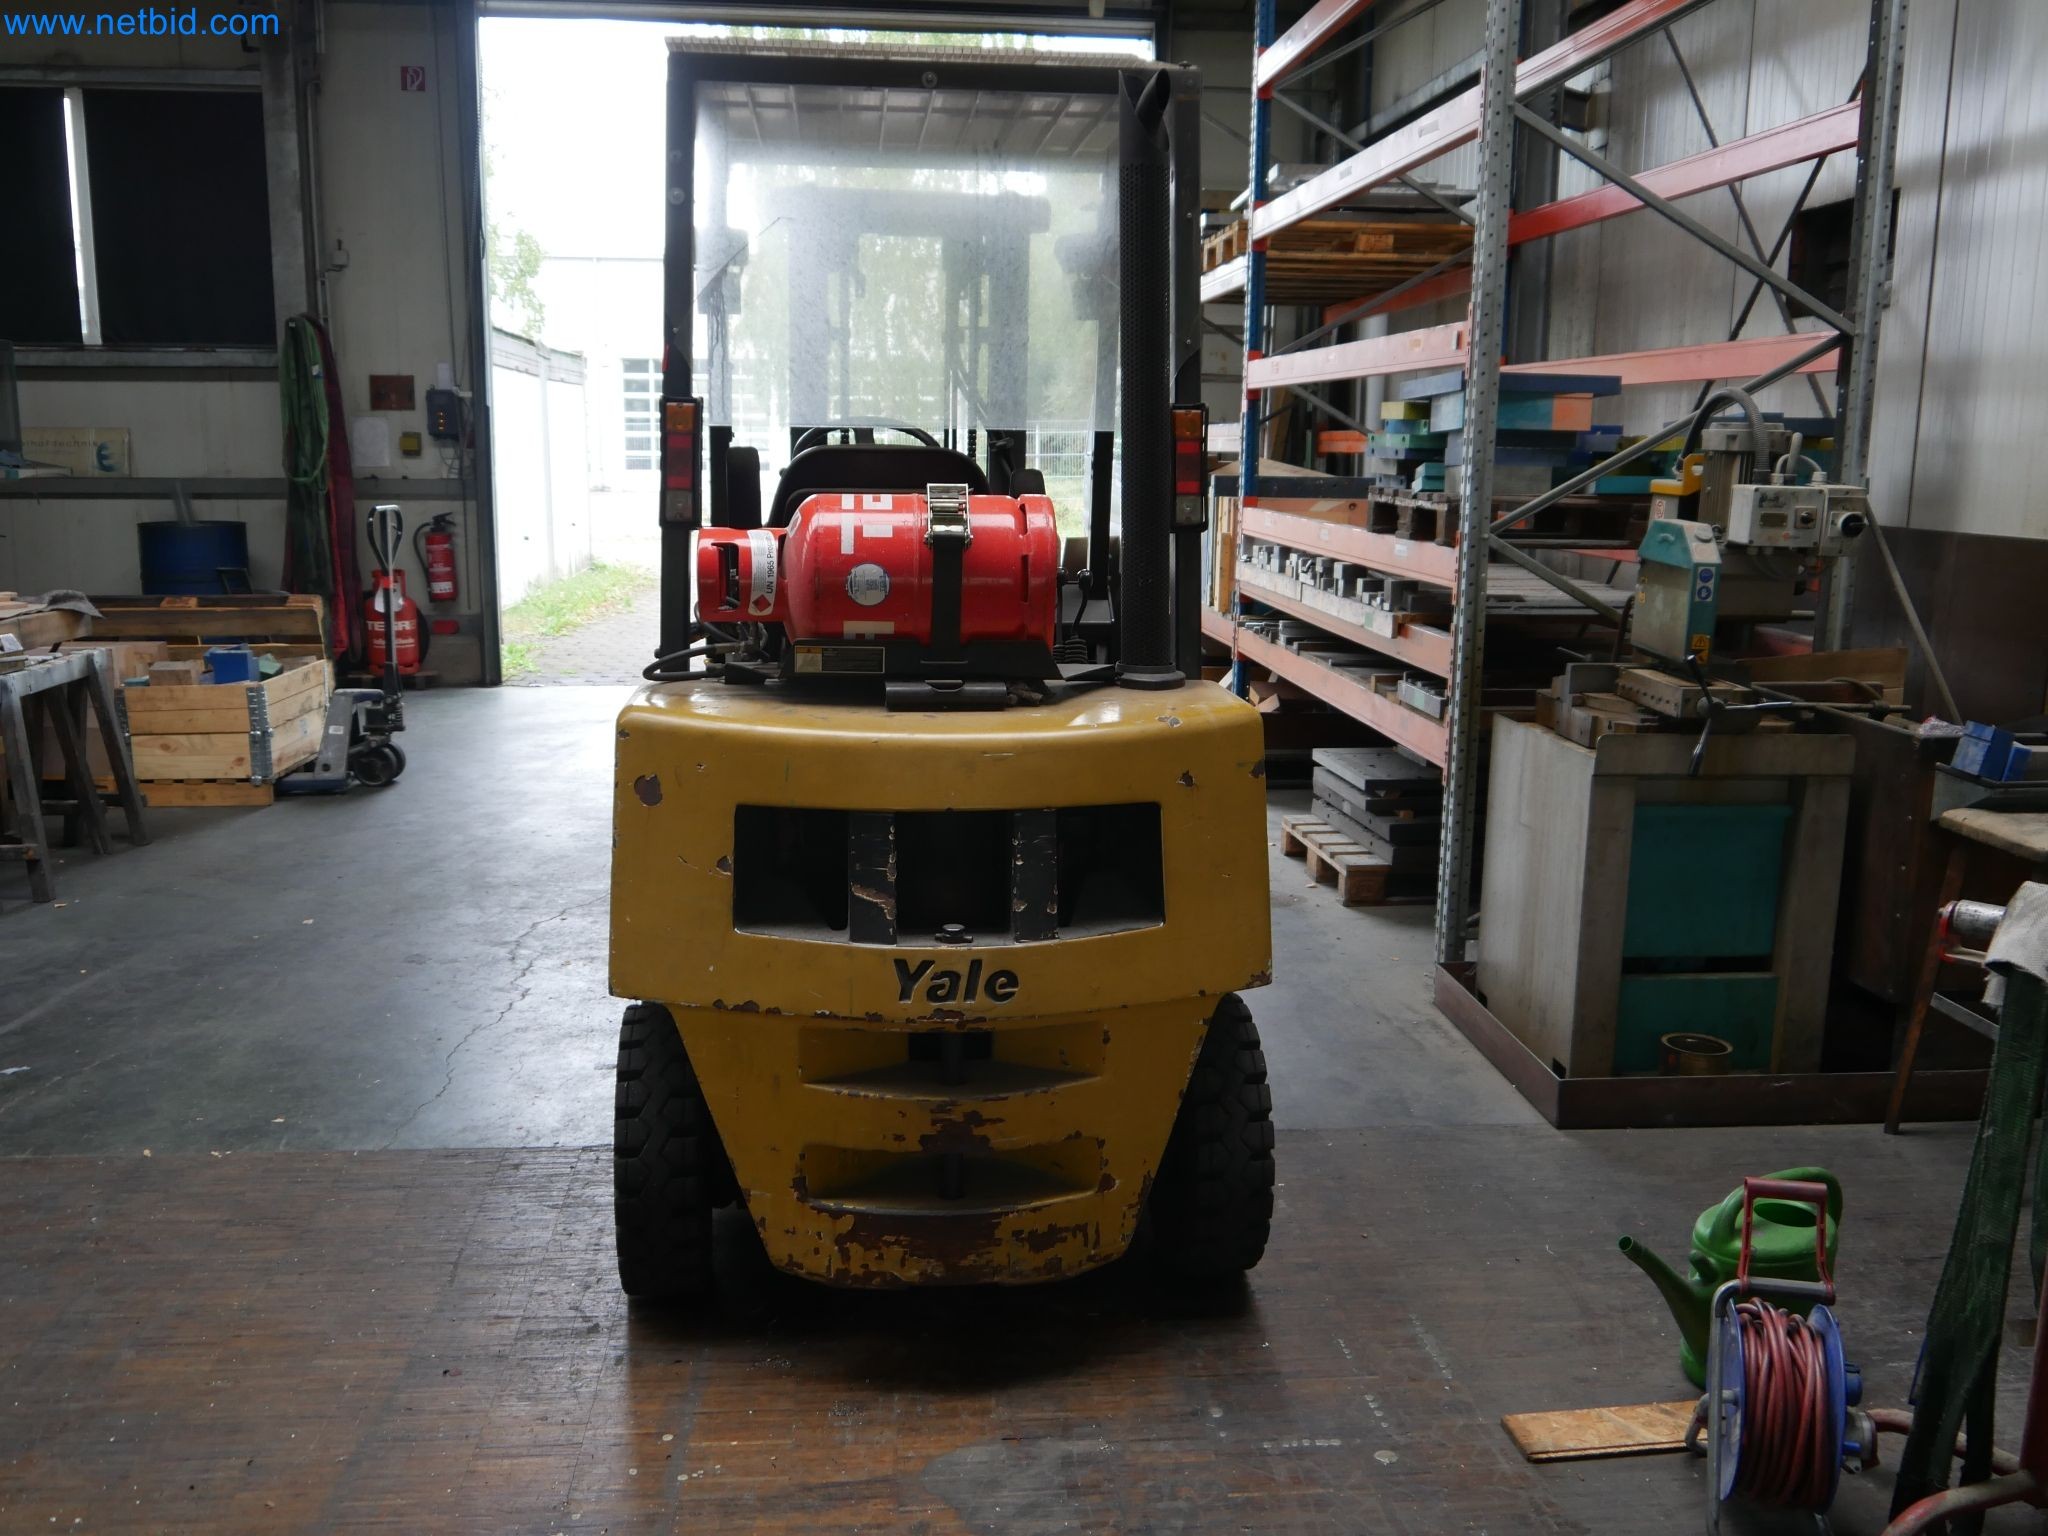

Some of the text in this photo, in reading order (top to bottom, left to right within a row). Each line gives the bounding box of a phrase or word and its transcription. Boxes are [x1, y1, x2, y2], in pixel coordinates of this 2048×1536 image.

[766, 560, 775, 578] 1965
[766, 581, 774, 594] UN
[893, 958, 1019, 1004] Yale
